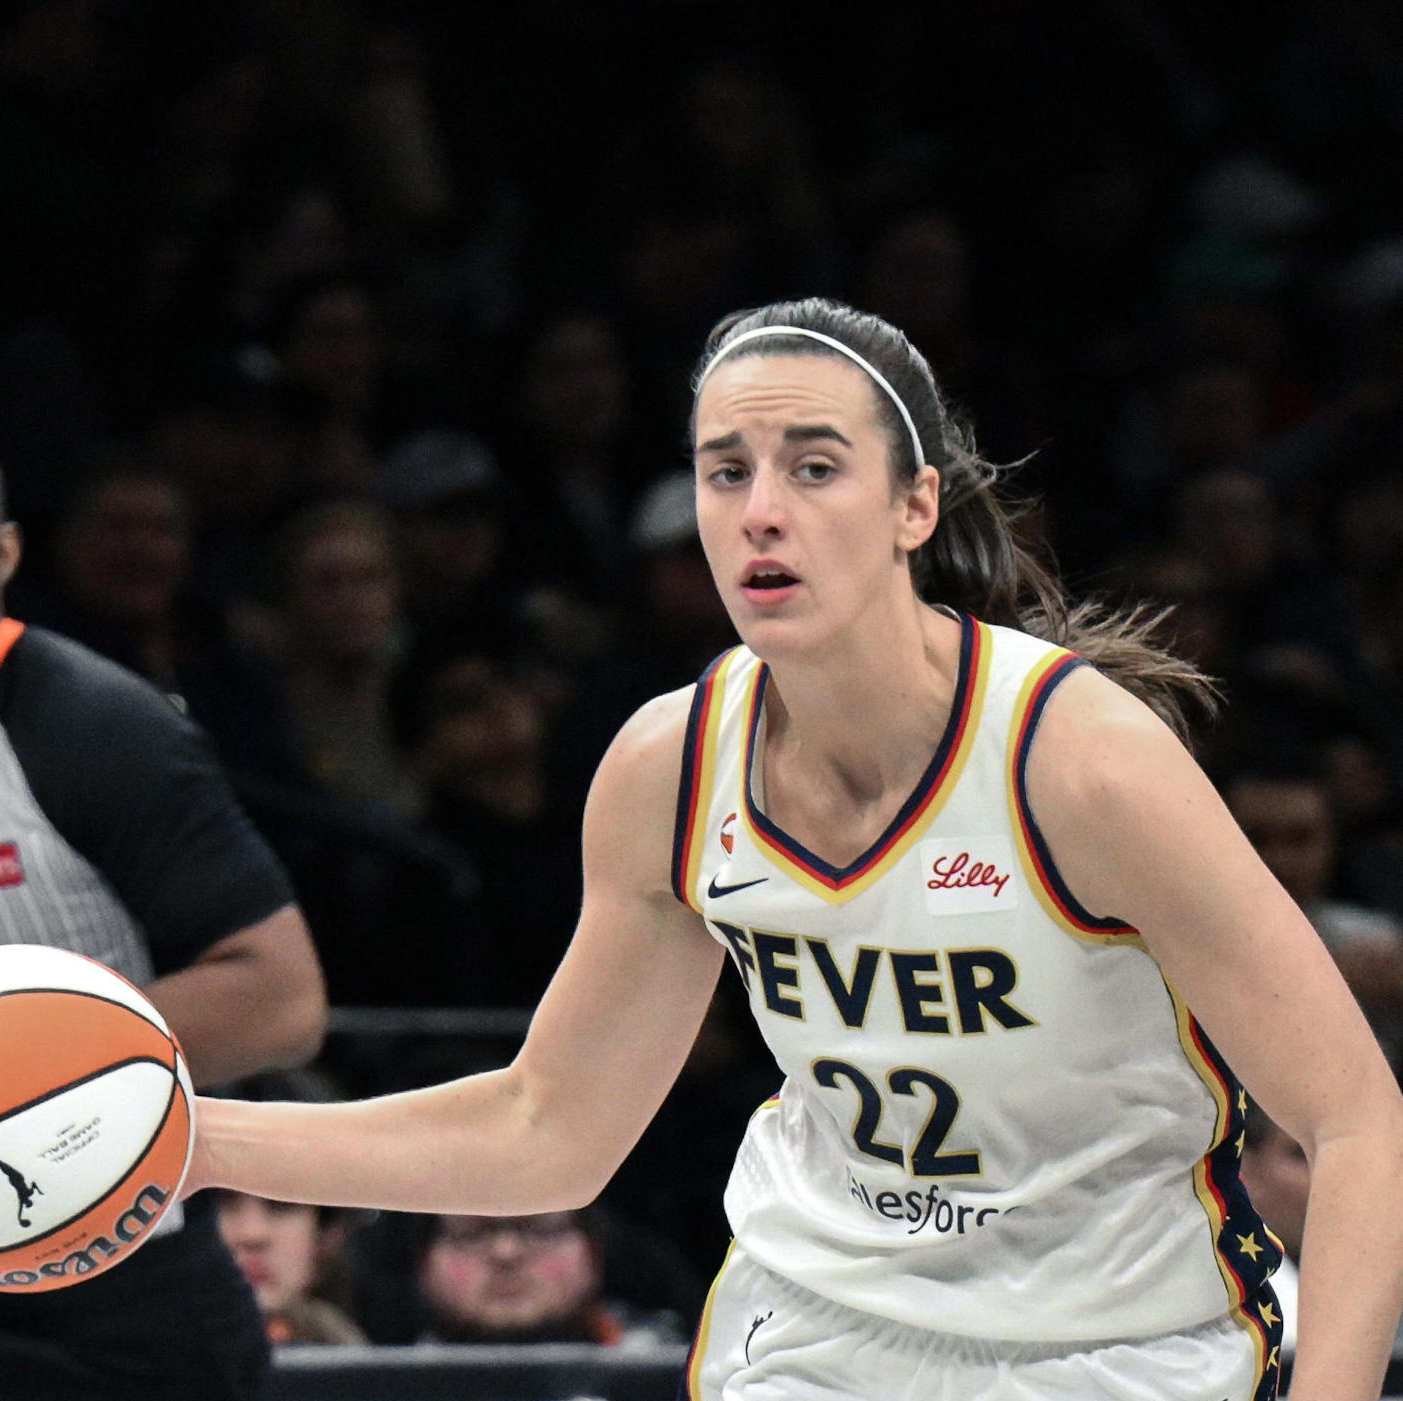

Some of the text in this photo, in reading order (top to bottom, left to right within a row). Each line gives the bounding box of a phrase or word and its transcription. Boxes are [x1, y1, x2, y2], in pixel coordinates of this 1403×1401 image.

[928, 853, 1010, 897] Lilly
[707, 918, 1040, 1037] FEVER
[810, 1056, 982, 1178] 22
